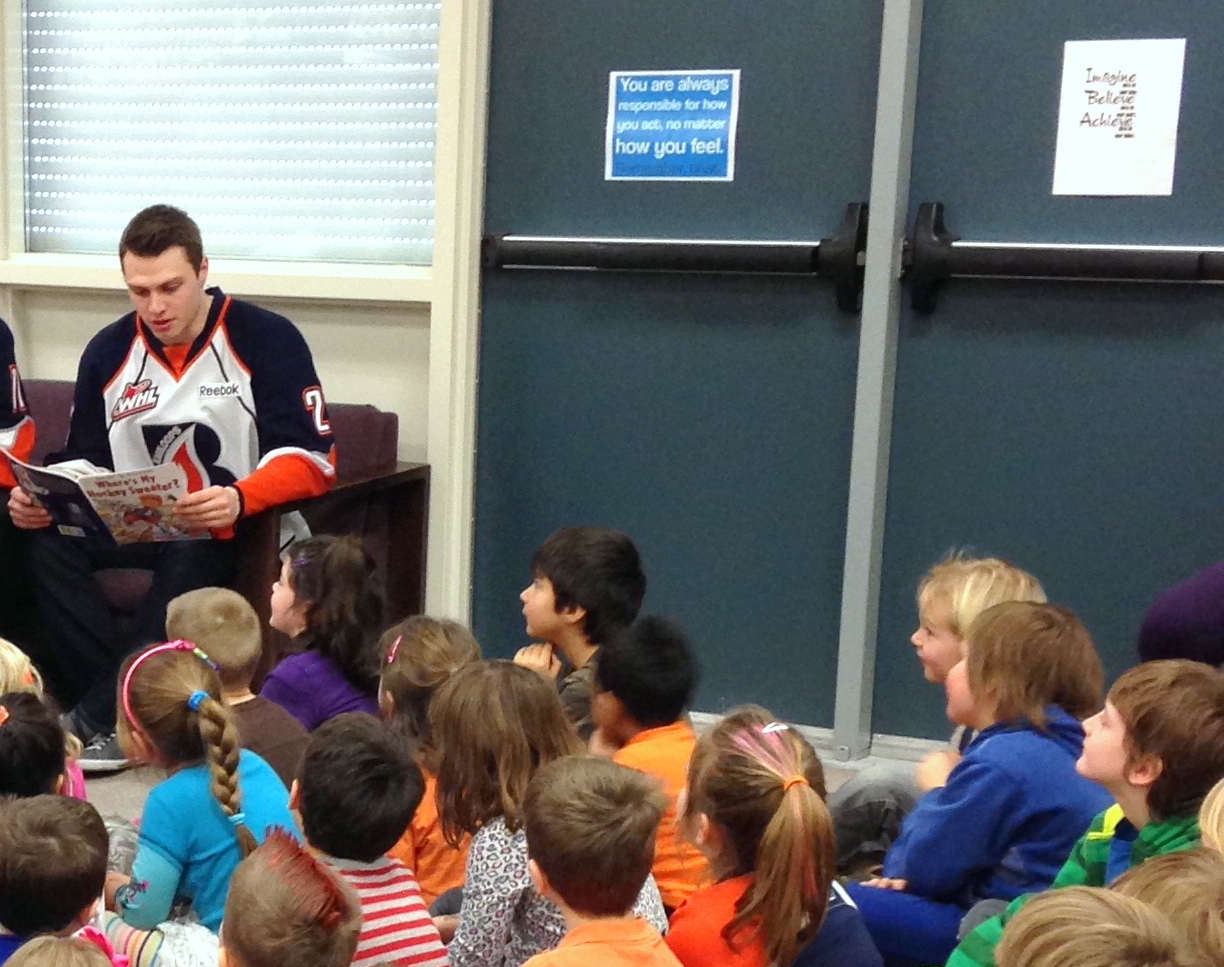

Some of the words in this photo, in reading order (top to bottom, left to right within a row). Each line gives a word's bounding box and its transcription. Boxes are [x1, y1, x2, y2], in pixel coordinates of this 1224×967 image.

[1085, 67, 1137, 86] Imagine
[620, 78, 647, 92] You
[651, 79, 674, 91] are
[678, 77, 728, 94] always
[1084, 90, 1135, 105] Believe
[618, 99, 681, 113] responsible
[684, 99, 700, 110] for
[702, 99, 727, 110] how
[616, 121, 639, 133] you
[641, 119, 663, 132] act,
[666, 120, 681, 130] no
[684, 119, 726, 130] matter
[1079, 112, 1133, 128] Achieve
[615, 138, 650, 154] how
[654, 141, 686, 159] you
[691, 138, 724, 154] feel.
[199, 384, 239, 397] Reebok
[116, 386, 159, 413] WHL
[140, 475, 155, 484] My
